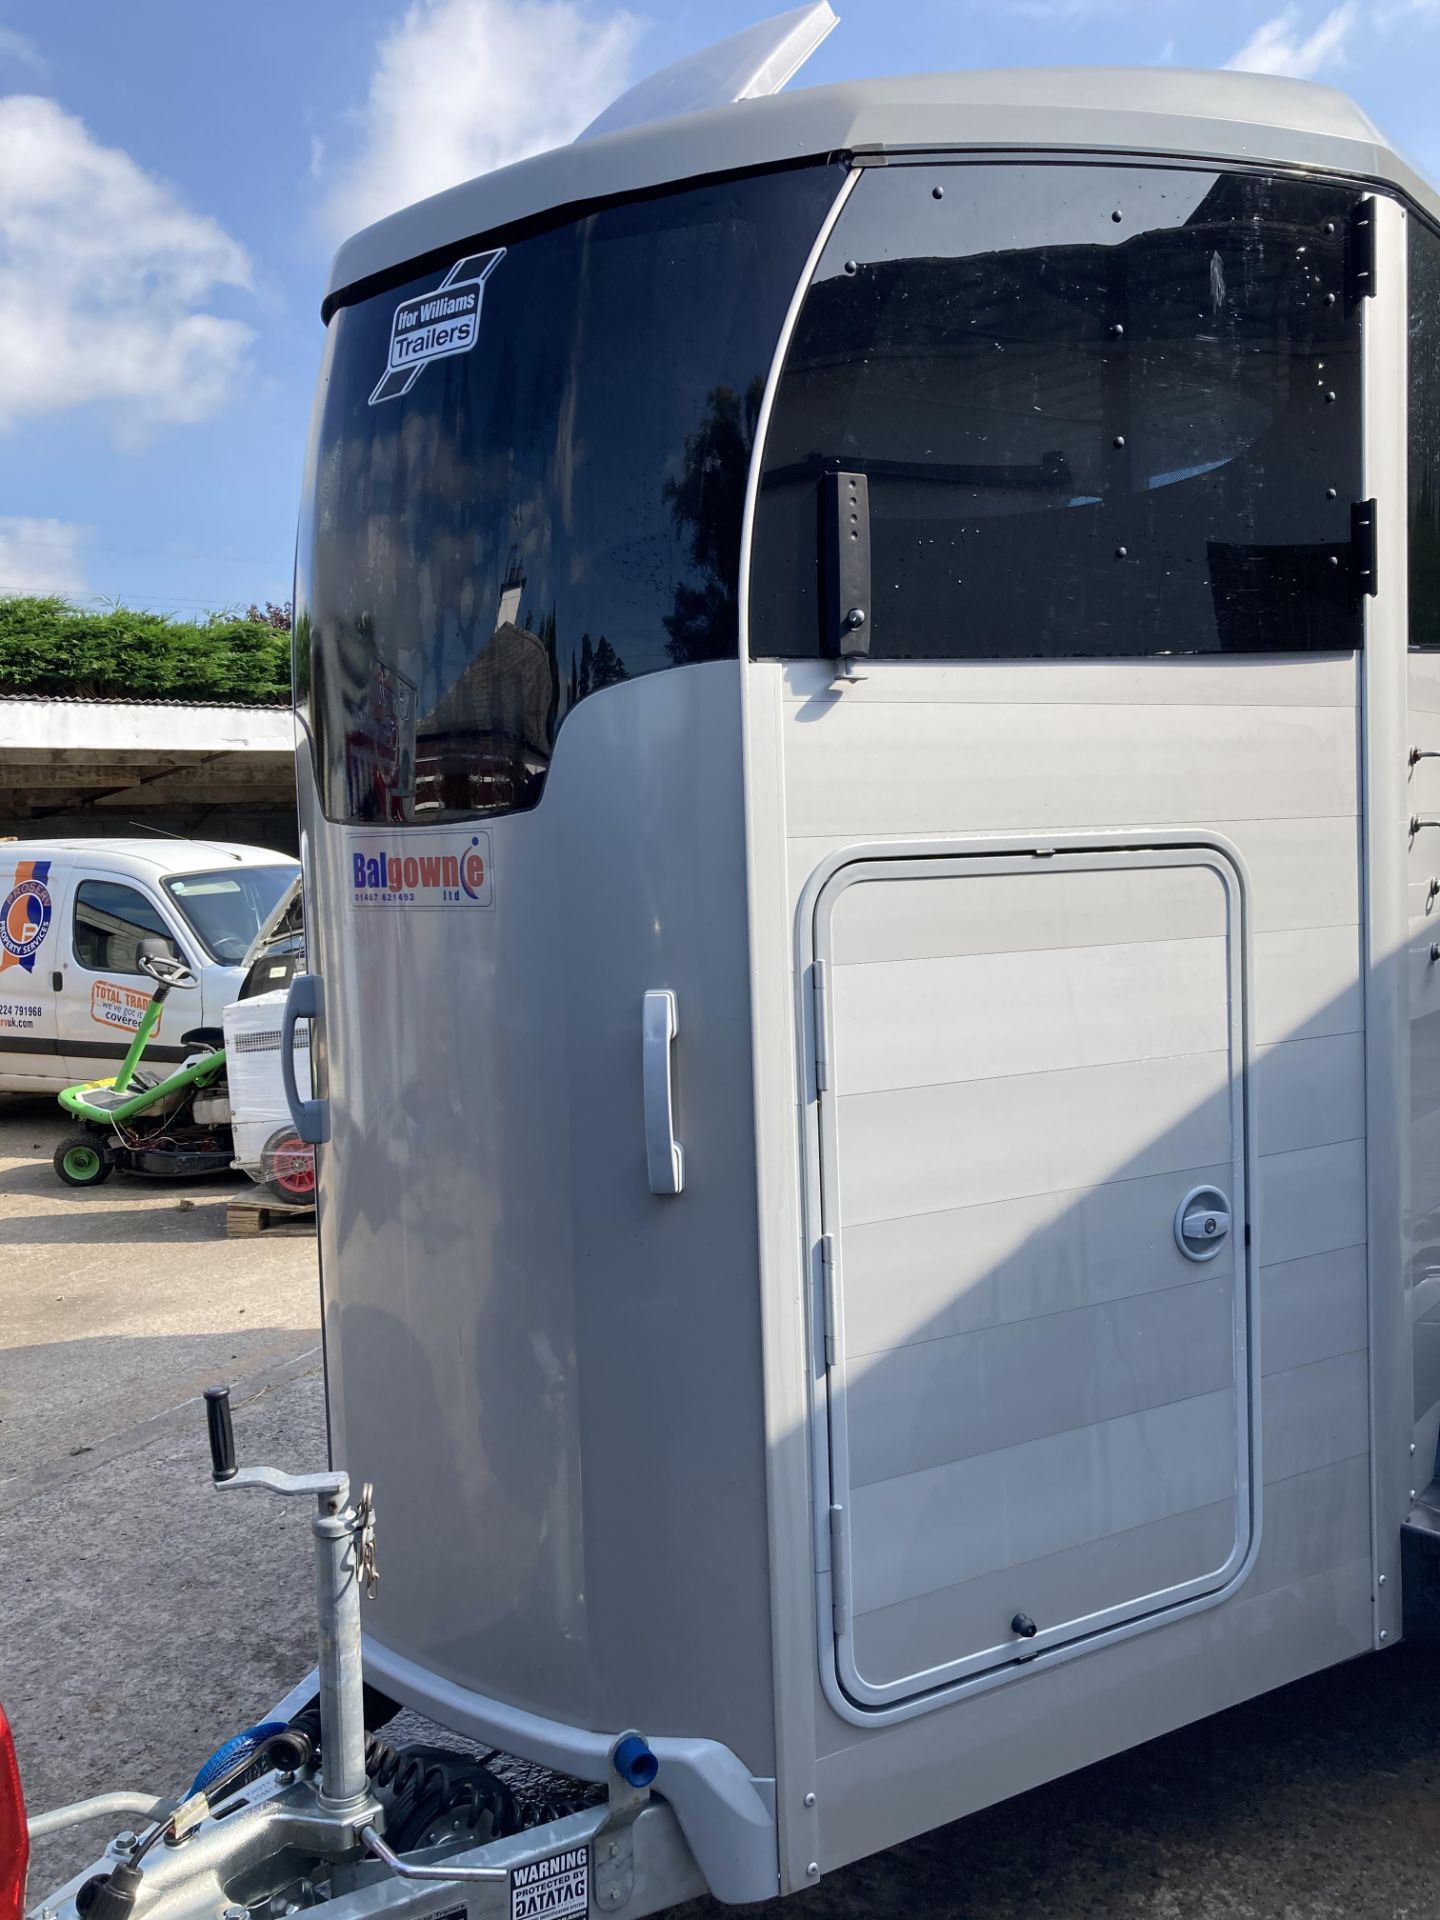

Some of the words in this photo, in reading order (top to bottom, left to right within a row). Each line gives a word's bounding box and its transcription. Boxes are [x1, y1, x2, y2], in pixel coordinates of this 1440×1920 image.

[398, 310, 419, 331] Ifor
[420, 293, 476, 322] Williams
[395, 322, 471, 359] Trailers
[7, 882, 51, 906] PROSERV
[382, 892, 415, 901] 621493
[443, 890, 460, 901] ltd
[0, 921, 21, 954] PROPERTY
[22, 921, 49, 954] SERVICES
[15, 1006, 42, 1017] 791968
[96, 986, 121, 1004] TOTAL
[125, 994, 149, 1011] TRAD
[123, 1008, 136, 1017] got
[513, 1848, 587, 1887] WARNING
[516, 1874, 571, 1899] PROTECTED
[573, 1870, 585, 1879] BY
[516, 1879, 585, 1918] DATATAG
